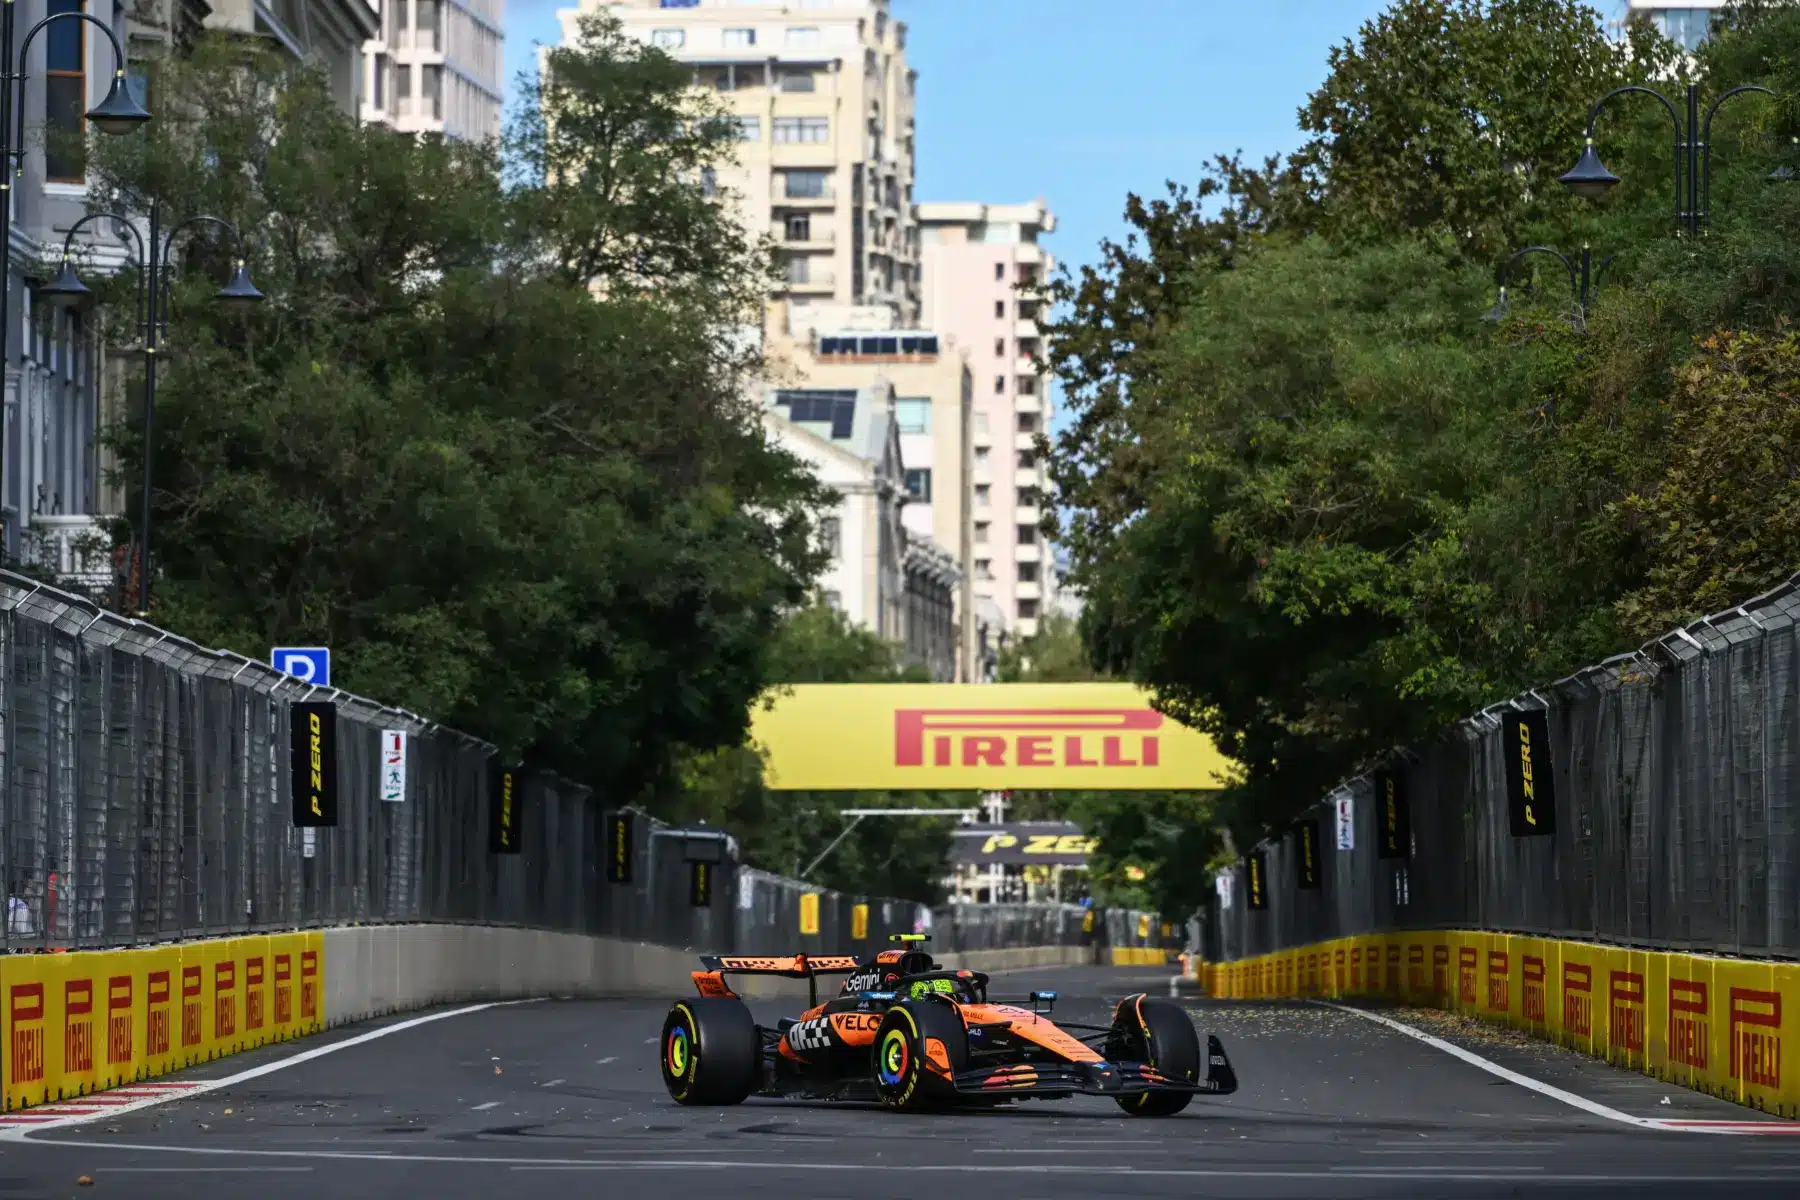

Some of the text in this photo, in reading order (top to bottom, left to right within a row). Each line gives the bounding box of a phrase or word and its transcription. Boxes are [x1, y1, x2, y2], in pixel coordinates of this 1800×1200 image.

[309, 712, 323, 817] P ZERO
[895, 709, 1163, 767] PIRELLI
[1519, 722, 1536, 826] P ZERO
[982, 835, 1099, 854] P ZER
[108, 975, 132, 1064] PIRELLI
[147, 971, 170, 1056] PIRELLI
[182, 966, 201, 1048] PIRELLI
[215, 961, 236, 1040] PIRELLI
[846, 967, 881, 992] Gemini
[1564, 962, 1592, 1037] PIRELLI
[1610, 970, 1644, 1051] PIRELLI
[11, 983, 44, 1084] PIRELLI
[65, 979, 93, 1073] PIRELLI
[834, 1014, 880, 1032] VELO
[1669, 977, 1708, 1070] PIRELLI
[1730, 986, 1781, 1089] PIRELLI
